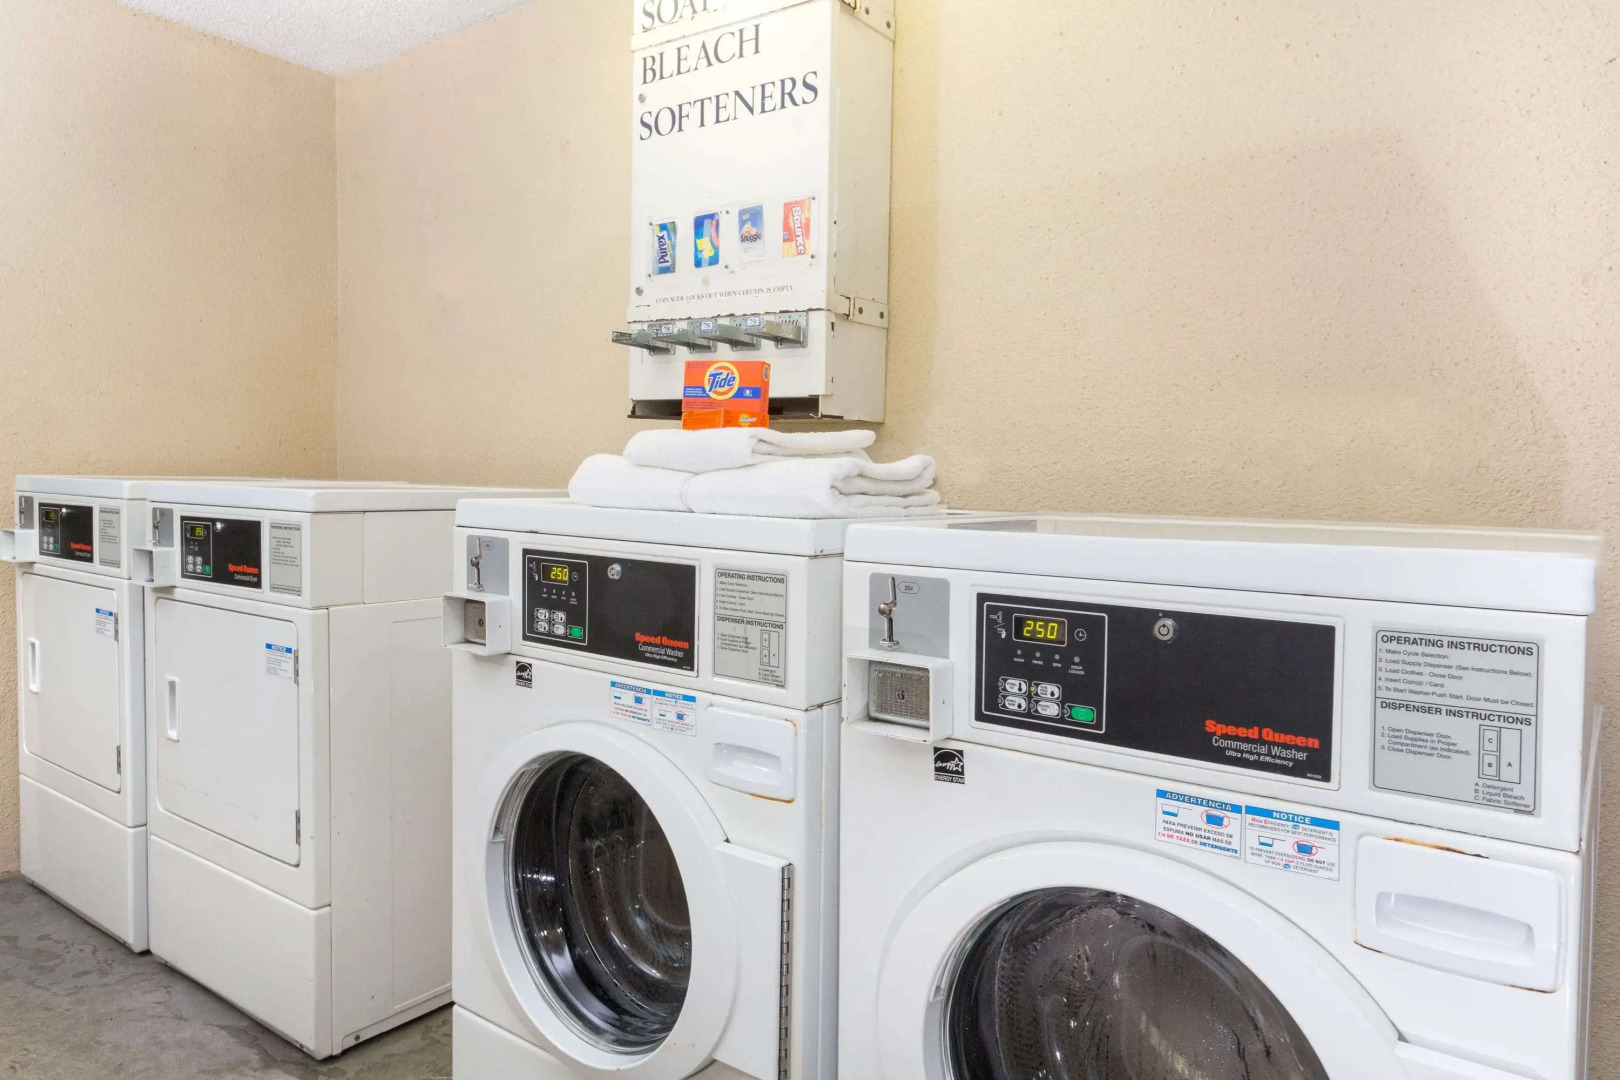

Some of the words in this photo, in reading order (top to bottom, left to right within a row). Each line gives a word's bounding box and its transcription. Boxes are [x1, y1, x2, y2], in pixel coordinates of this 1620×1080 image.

[642, 0, 708, 29] SOA
[641, 24, 761, 85] BLEACH
[639, 71, 818, 141] SOFTENERS
[791, 205, 806, 255] Bounce
[656, 234, 670, 264] Purex
[708, 370, 736, 392] Tide
[550, 567, 568, 581] 250
[718, 572, 746, 580] OPERATING
[746, 574, 784, 584] INSTRUCTIONS
[717, 616, 744, 624] DISPENSER
[746, 620, 784, 630] INSTRUCTIONS
[1024, 620, 1058, 638] 250
[635, 632, 661, 644] Speed
[662, 636, 690, 649] Queen
[1381, 635, 1444, 648] OPERATING
[1447, 640, 1534, 656] INSTRUCTIONS
[638, 644, 666, 654] Commercial
[666, 648, 684, 658] Washer
[1401, 659, 1422, 668] Supply
[1423, 662, 1454, 670] Dispenser
[1455, 664, 1470, 672] (See
[1470, 666, 1508, 674] Instructions
[1401, 668, 1424, 676] Clothes
[1484, 696, 1499, 704] Must
[1510, 700, 1534, 708] Closed
[1380, 700, 1442, 716] DISPENSER
[1446, 708, 1532, 726] INSTRUCTIONS
[1205, 719, 1260, 740] Speed
[1262, 728, 1320, 748] Queen
[1404, 735, 1429, 744] Supplies
[1405, 728, 1434, 737] Dispenser
[1212, 736, 1268, 754] Commercial
[1271, 746, 1308, 760] Washer
[1388, 740, 1428, 749] Compartment
[1226, 750, 1240, 758] Ultra
[1242, 752, 1258, 761] High
[1260, 755, 1294, 768] Efficiency
[1406, 748, 1435, 757] Dispenser
[1482, 782, 1514, 792] Detergent
[1166, 792, 1232, 811] ADVERTENCIA
[1482, 790, 1501, 798] Liquid
[1502, 792, 1525, 801] Bleach
[1482, 796, 1502, 805] Fabric
[1504, 800, 1530, 808] Softener
[1272, 812, 1311, 824] NOTICE
[1163, 826, 1184, 836] ESPUMA
[1195, 832, 1211, 840] USAR
[1176, 822, 1202, 832] PREVENIR
[1204, 828, 1224, 838] EXCESO
[1248, 822, 1280, 832] RECOMMENDED
[1303, 832, 1336, 842] PERFORMANCE
[1302, 826, 1328, 836] DETERGENT
[1200, 841, 1238, 854] DETERGENTE
[1292, 866, 1319, 874] DETERGENT
